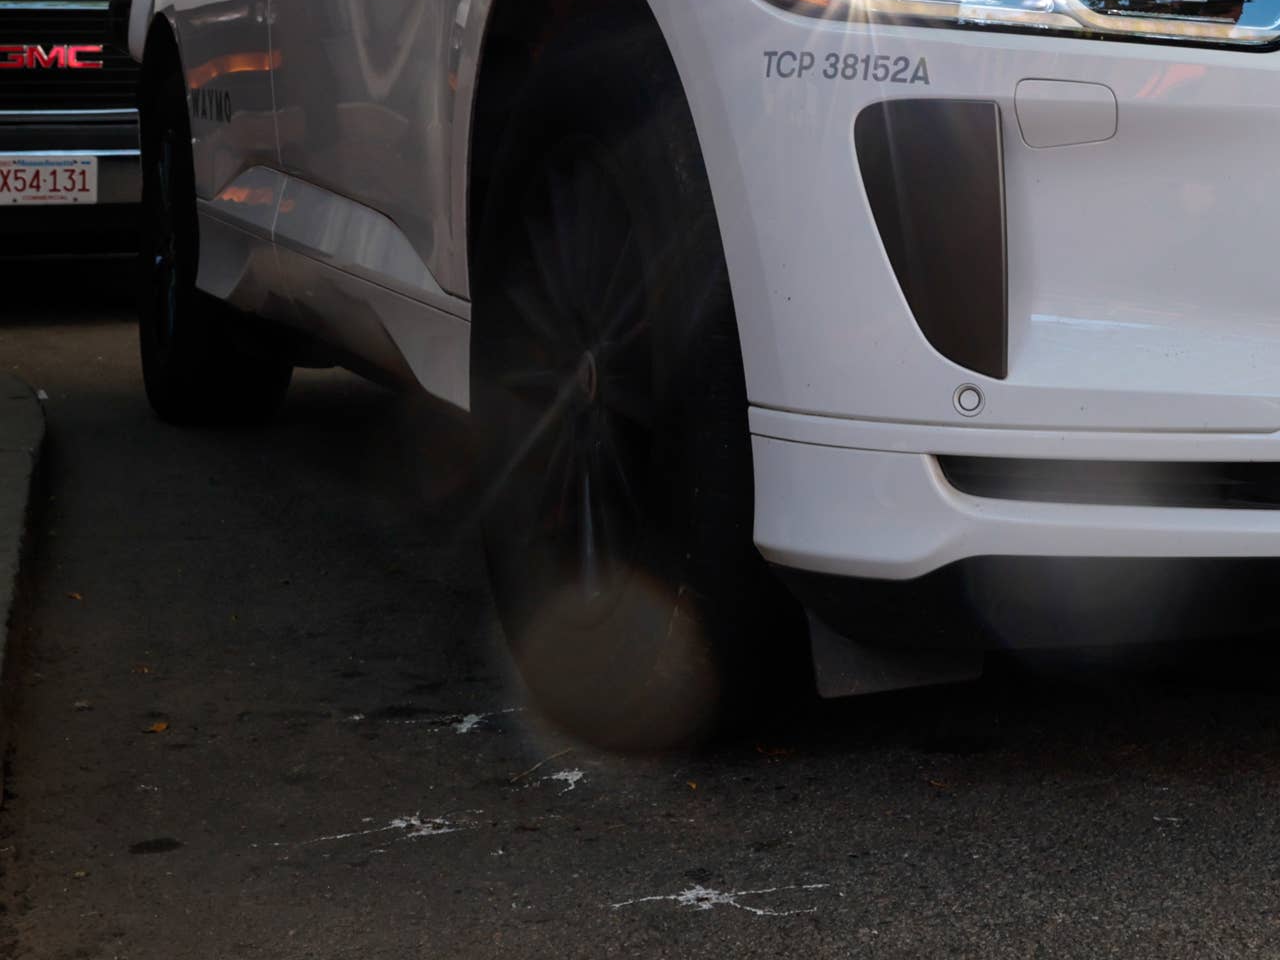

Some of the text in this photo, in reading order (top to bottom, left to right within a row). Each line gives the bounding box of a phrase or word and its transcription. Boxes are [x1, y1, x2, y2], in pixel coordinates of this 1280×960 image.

[0, 44, 103, 68] GMC
[763, 50, 930, 85] TCP 38152A
